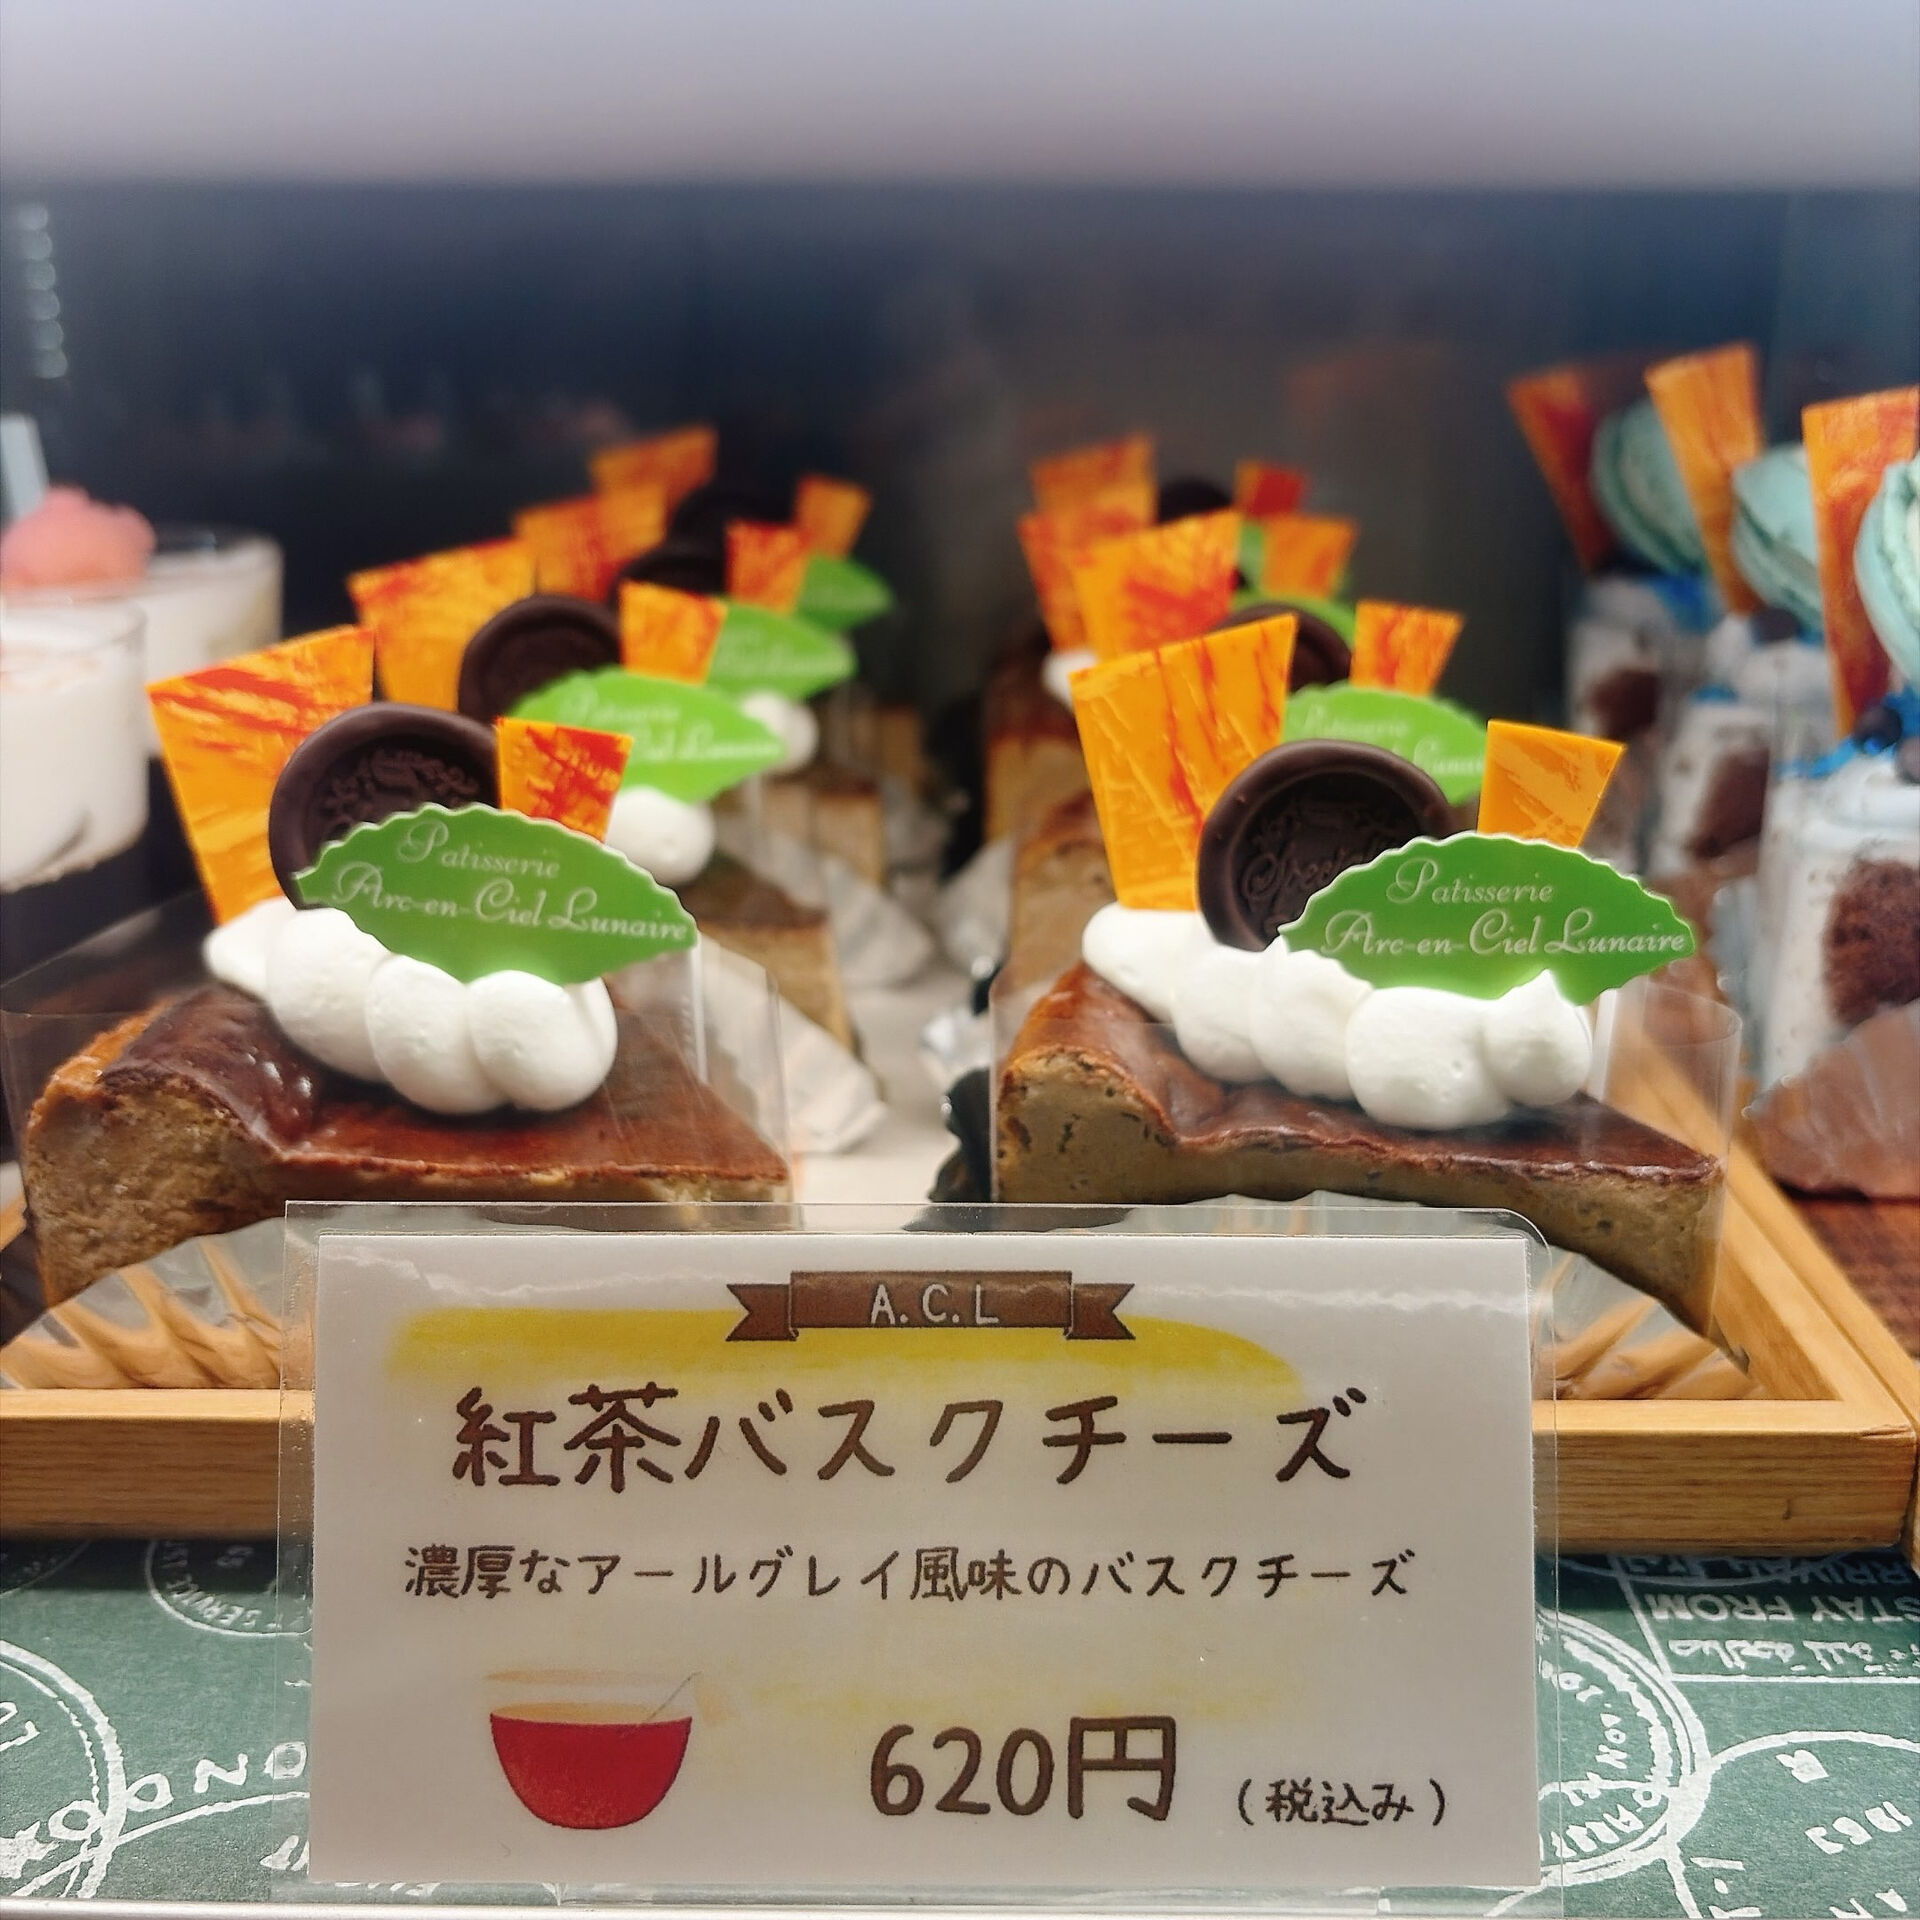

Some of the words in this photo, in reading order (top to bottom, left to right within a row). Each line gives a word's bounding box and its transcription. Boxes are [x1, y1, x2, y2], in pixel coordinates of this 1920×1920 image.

[398, 818, 560, 878] Patisserie
[333, 862, 544, 926] Arc-en-Ciel
[548, 887, 689, 940] Lunaire
[1387, 856, 1554, 905] Patisserie
[1322, 909, 1540, 956] Arc-en-Ciel
[1545, 908, 1686, 953] Lunaire
[871, 1282, 1000, 1327] A.C.L
[452, 1381, 1367, 1493] 紅茶バスクチーズ
[404, 1542, 1416, 1602] 濃厚なアールグレイ風味のバスクチーズ
[1644, 1593, 1794, 1623] FROM
[871, 1715, 1177, 1821] 620円
[1237, 1777, 1447, 1826] (税込み)
